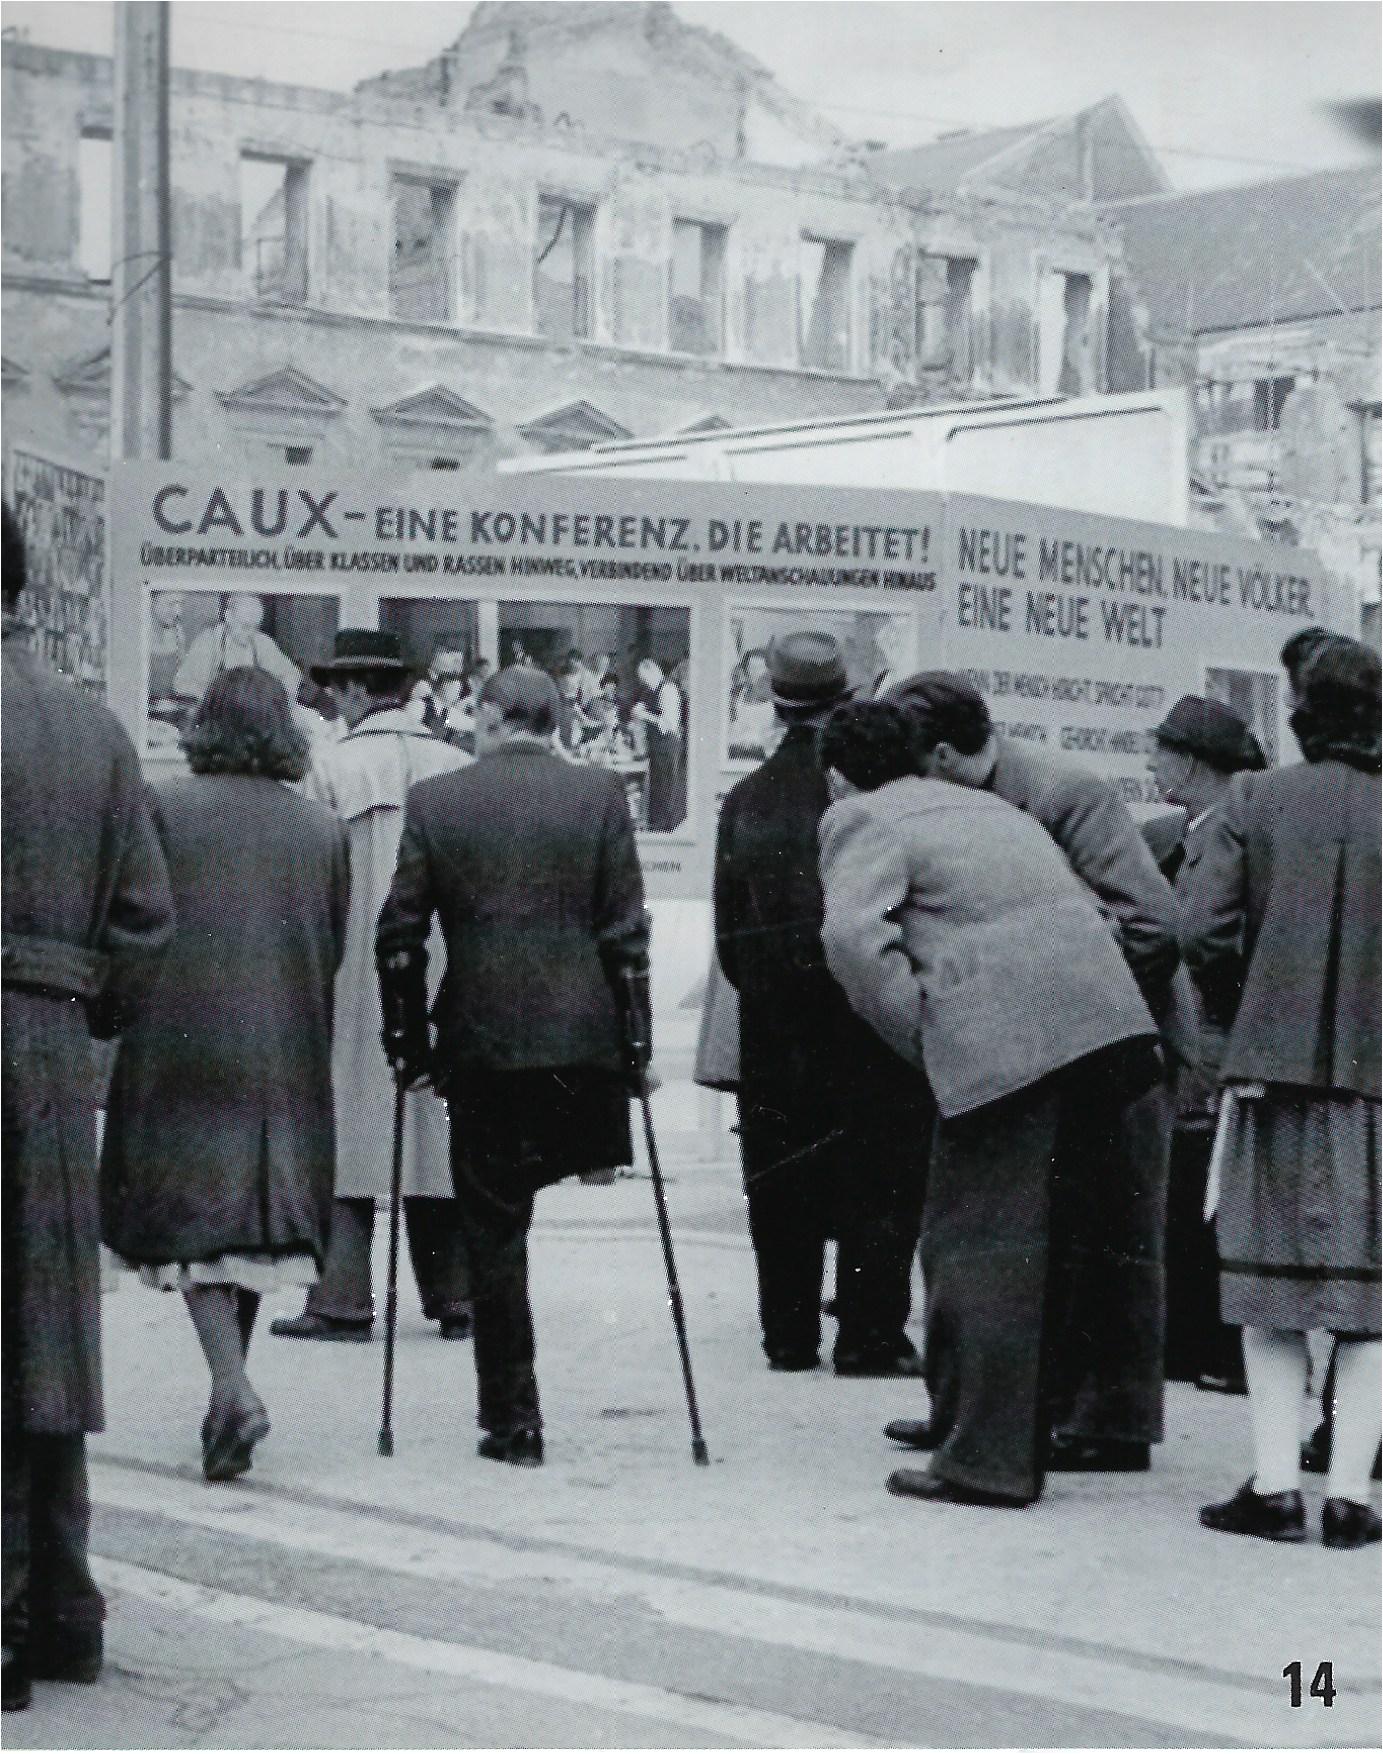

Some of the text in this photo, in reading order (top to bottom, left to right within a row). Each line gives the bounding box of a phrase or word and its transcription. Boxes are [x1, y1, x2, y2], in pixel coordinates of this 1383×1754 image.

[375, 506, 459, 544] EINE
[708, 518, 763, 554] DIE
[771, 521, 931, 564] ARBEITET!
[958, 526, 1026, 579] NEUE
[1172, 556, 1232, 606] NEUE
[284, 543, 325, 570] ÜBER
[329, 550, 400, 574] KLASSEN
[402, 552, 439, 573] UND
[442, 554, 506, 576] RASSEN
[676, 556, 717, 583] ÜBER
[882, 569, 937, 592] HINAUS
[957, 582, 1167, 649] EINE NEUE WELT
